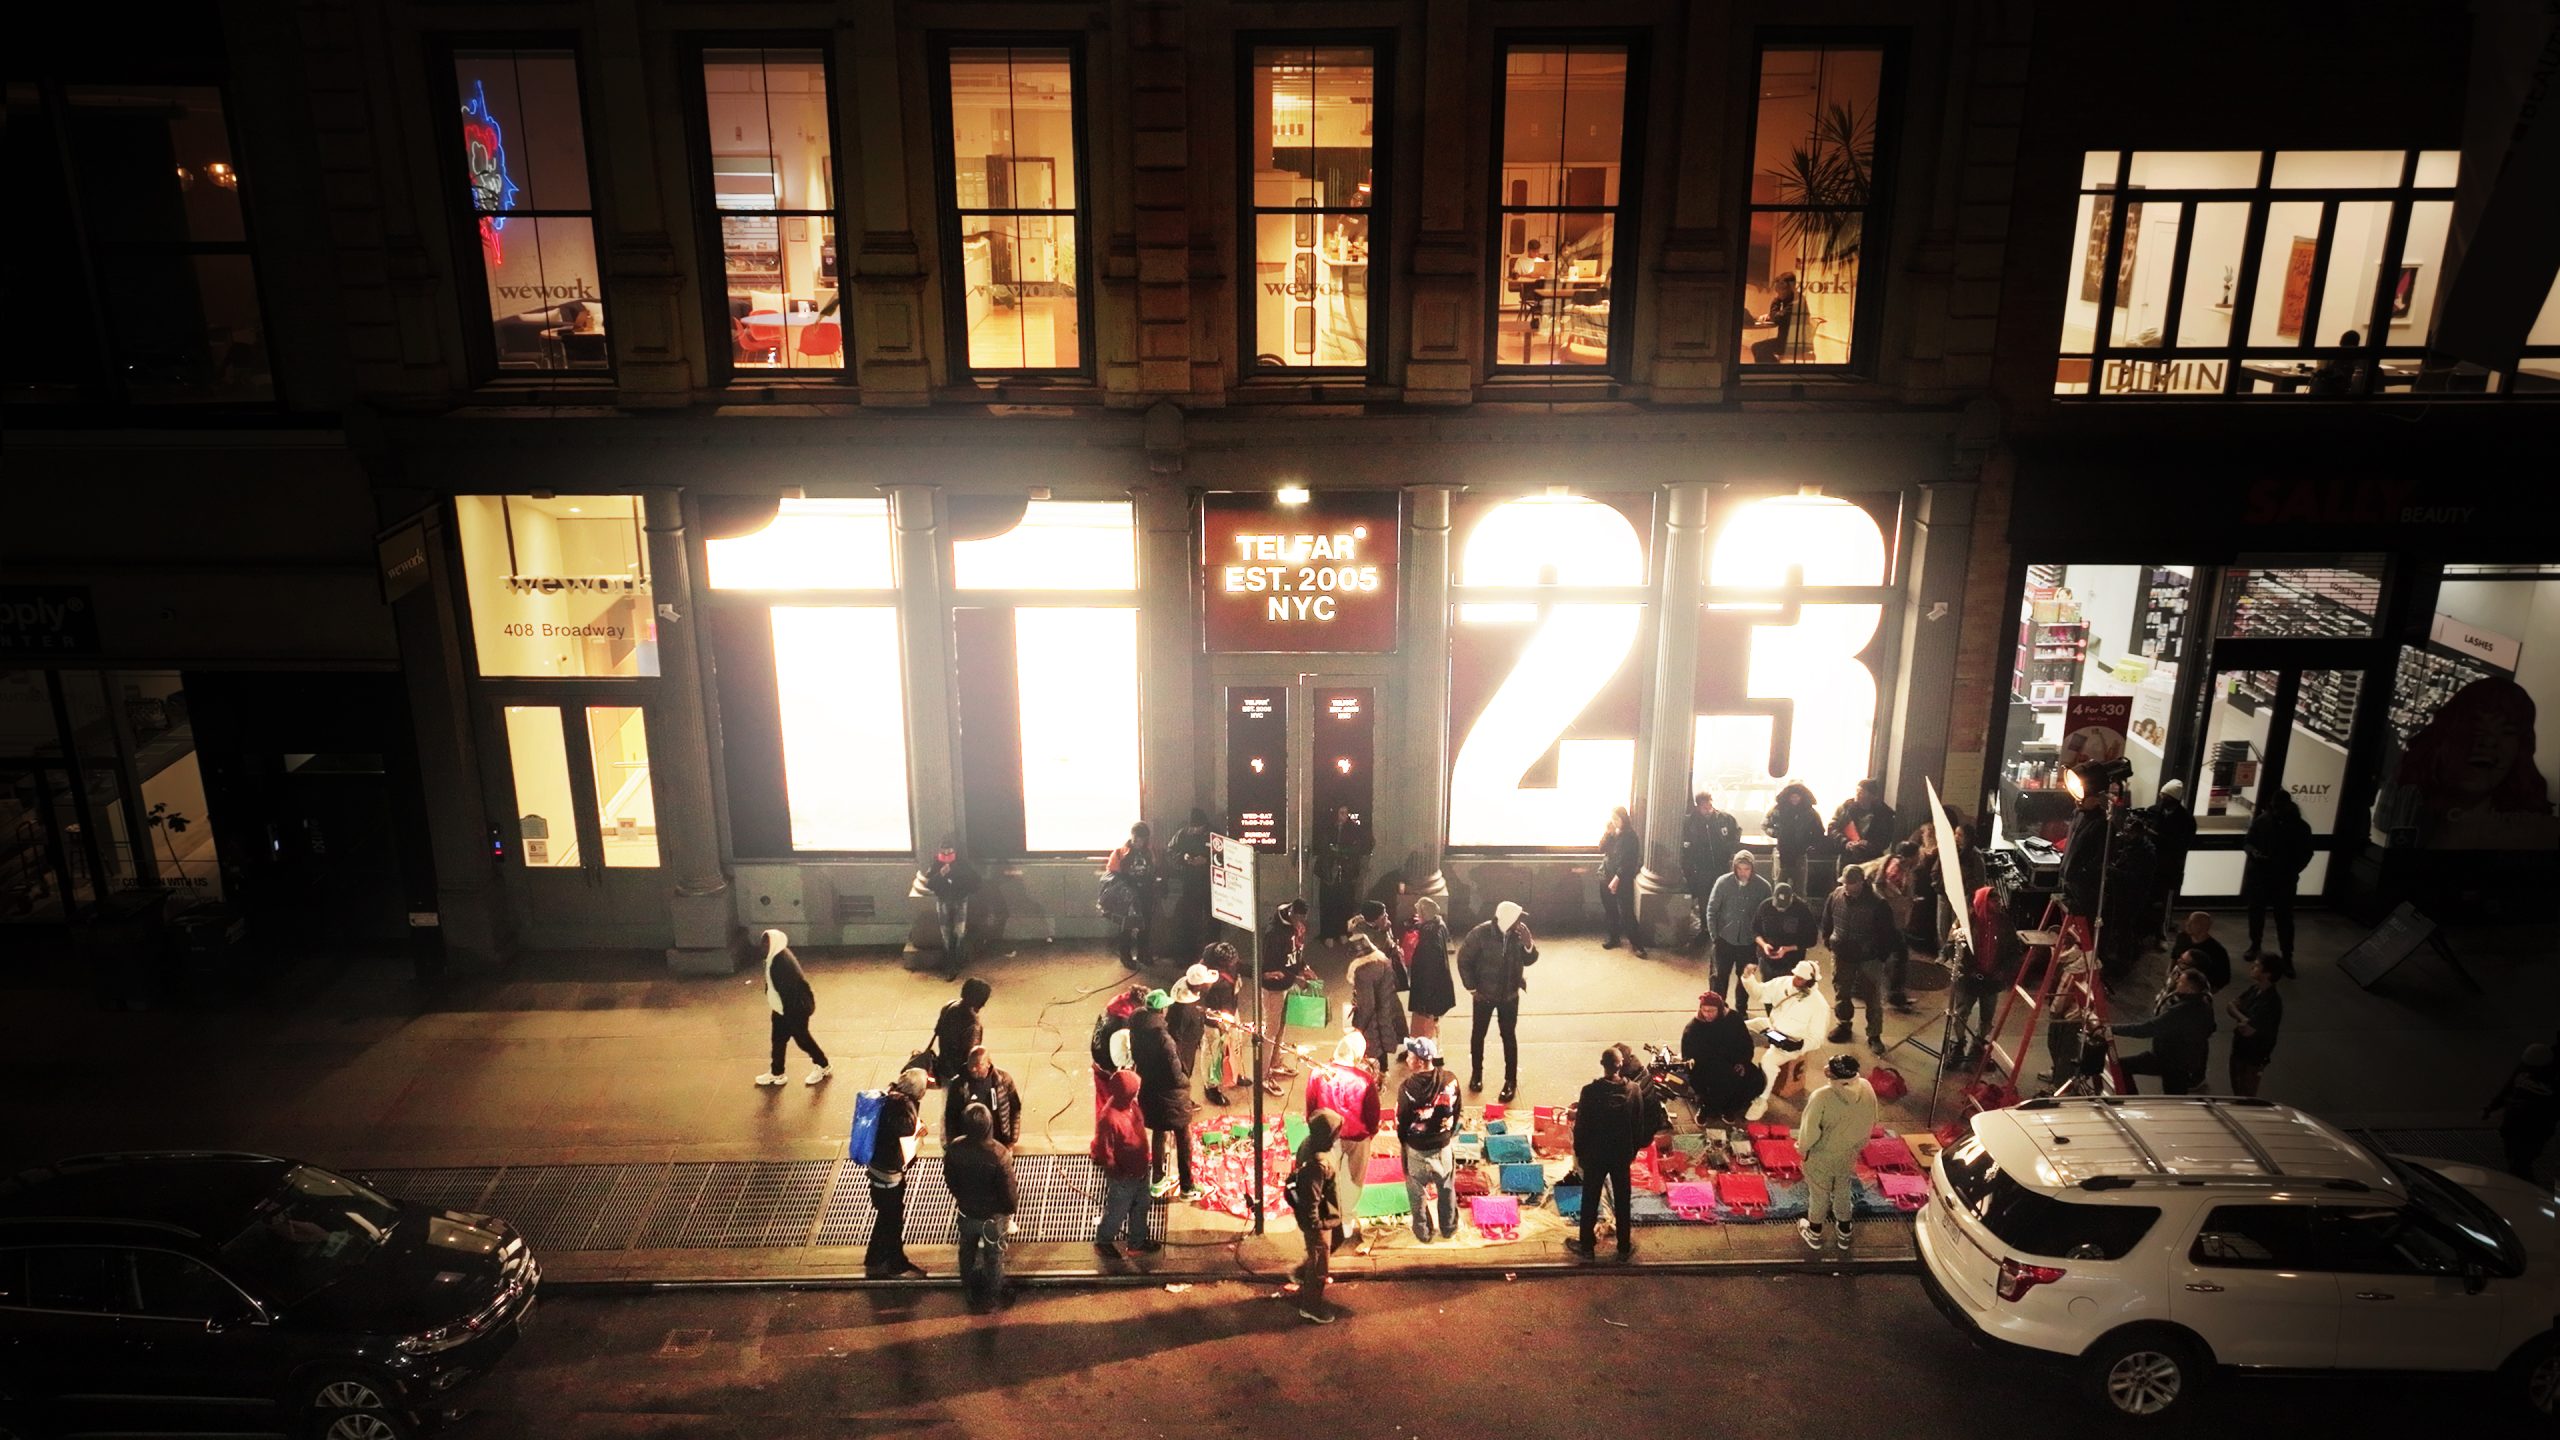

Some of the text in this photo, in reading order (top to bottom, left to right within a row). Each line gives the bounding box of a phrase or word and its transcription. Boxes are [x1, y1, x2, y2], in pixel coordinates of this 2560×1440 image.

[497, 277, 594, 299] wework
[2106, 362, 2223, 391] DIMIN
[2240, 479, 2477, 524] SALLY BEAUTY
[386, 547, 425, 579] wework
[506, 568, 651, 596] wework
[1225, 567, 1378, 592] EST. 2005
[1268, 596, 1337, 621] NYC
[504, 623, 626, 640] 408 Broadway
[2464, 634, 2494, 652] LASHES
[2072, 704, 2084, 715] 4
[2101, 704, 2126, 716] $30
[2291, 784, 2331, 794] SALLY
